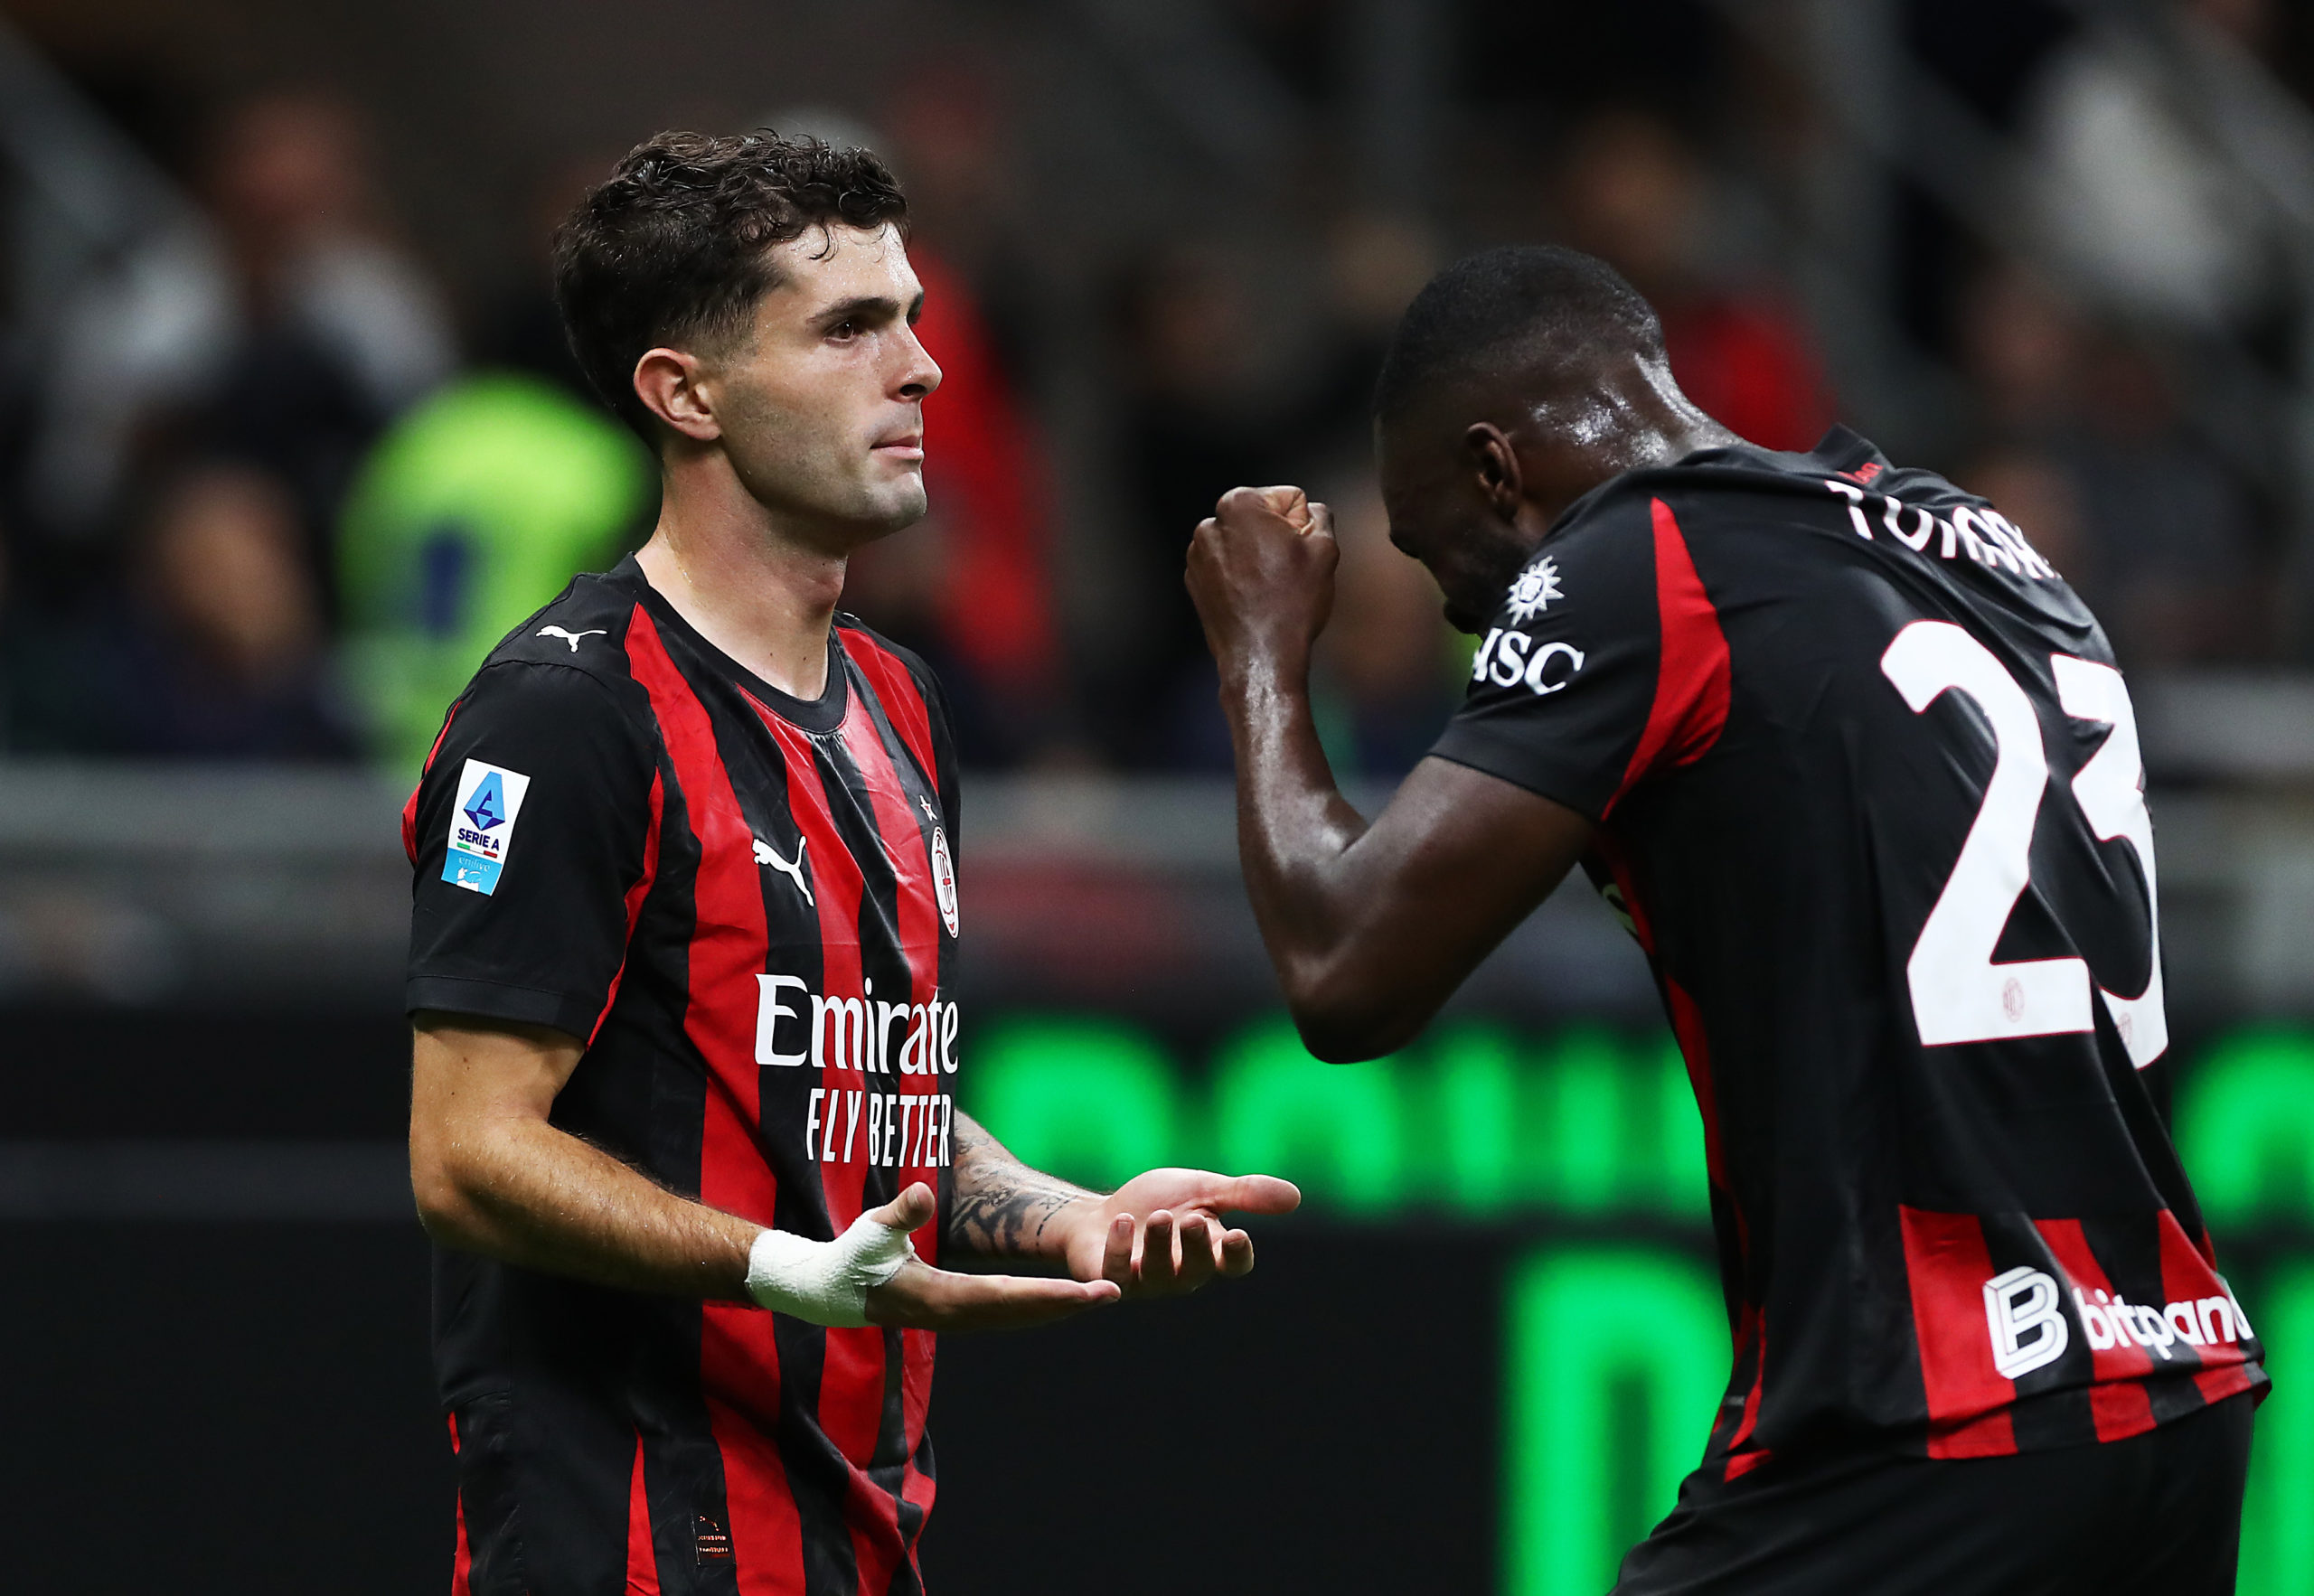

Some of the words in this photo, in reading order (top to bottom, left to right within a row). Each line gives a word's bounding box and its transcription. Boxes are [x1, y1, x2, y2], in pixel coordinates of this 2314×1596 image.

[457, 828, 490, 848] SERIE
[491, 839, 500, 851] A
[1880, 619, 2169, 1071] 23
[806, 1088, 863, 1163] FLY
[869, 1093, 952, 1168] BETTER
